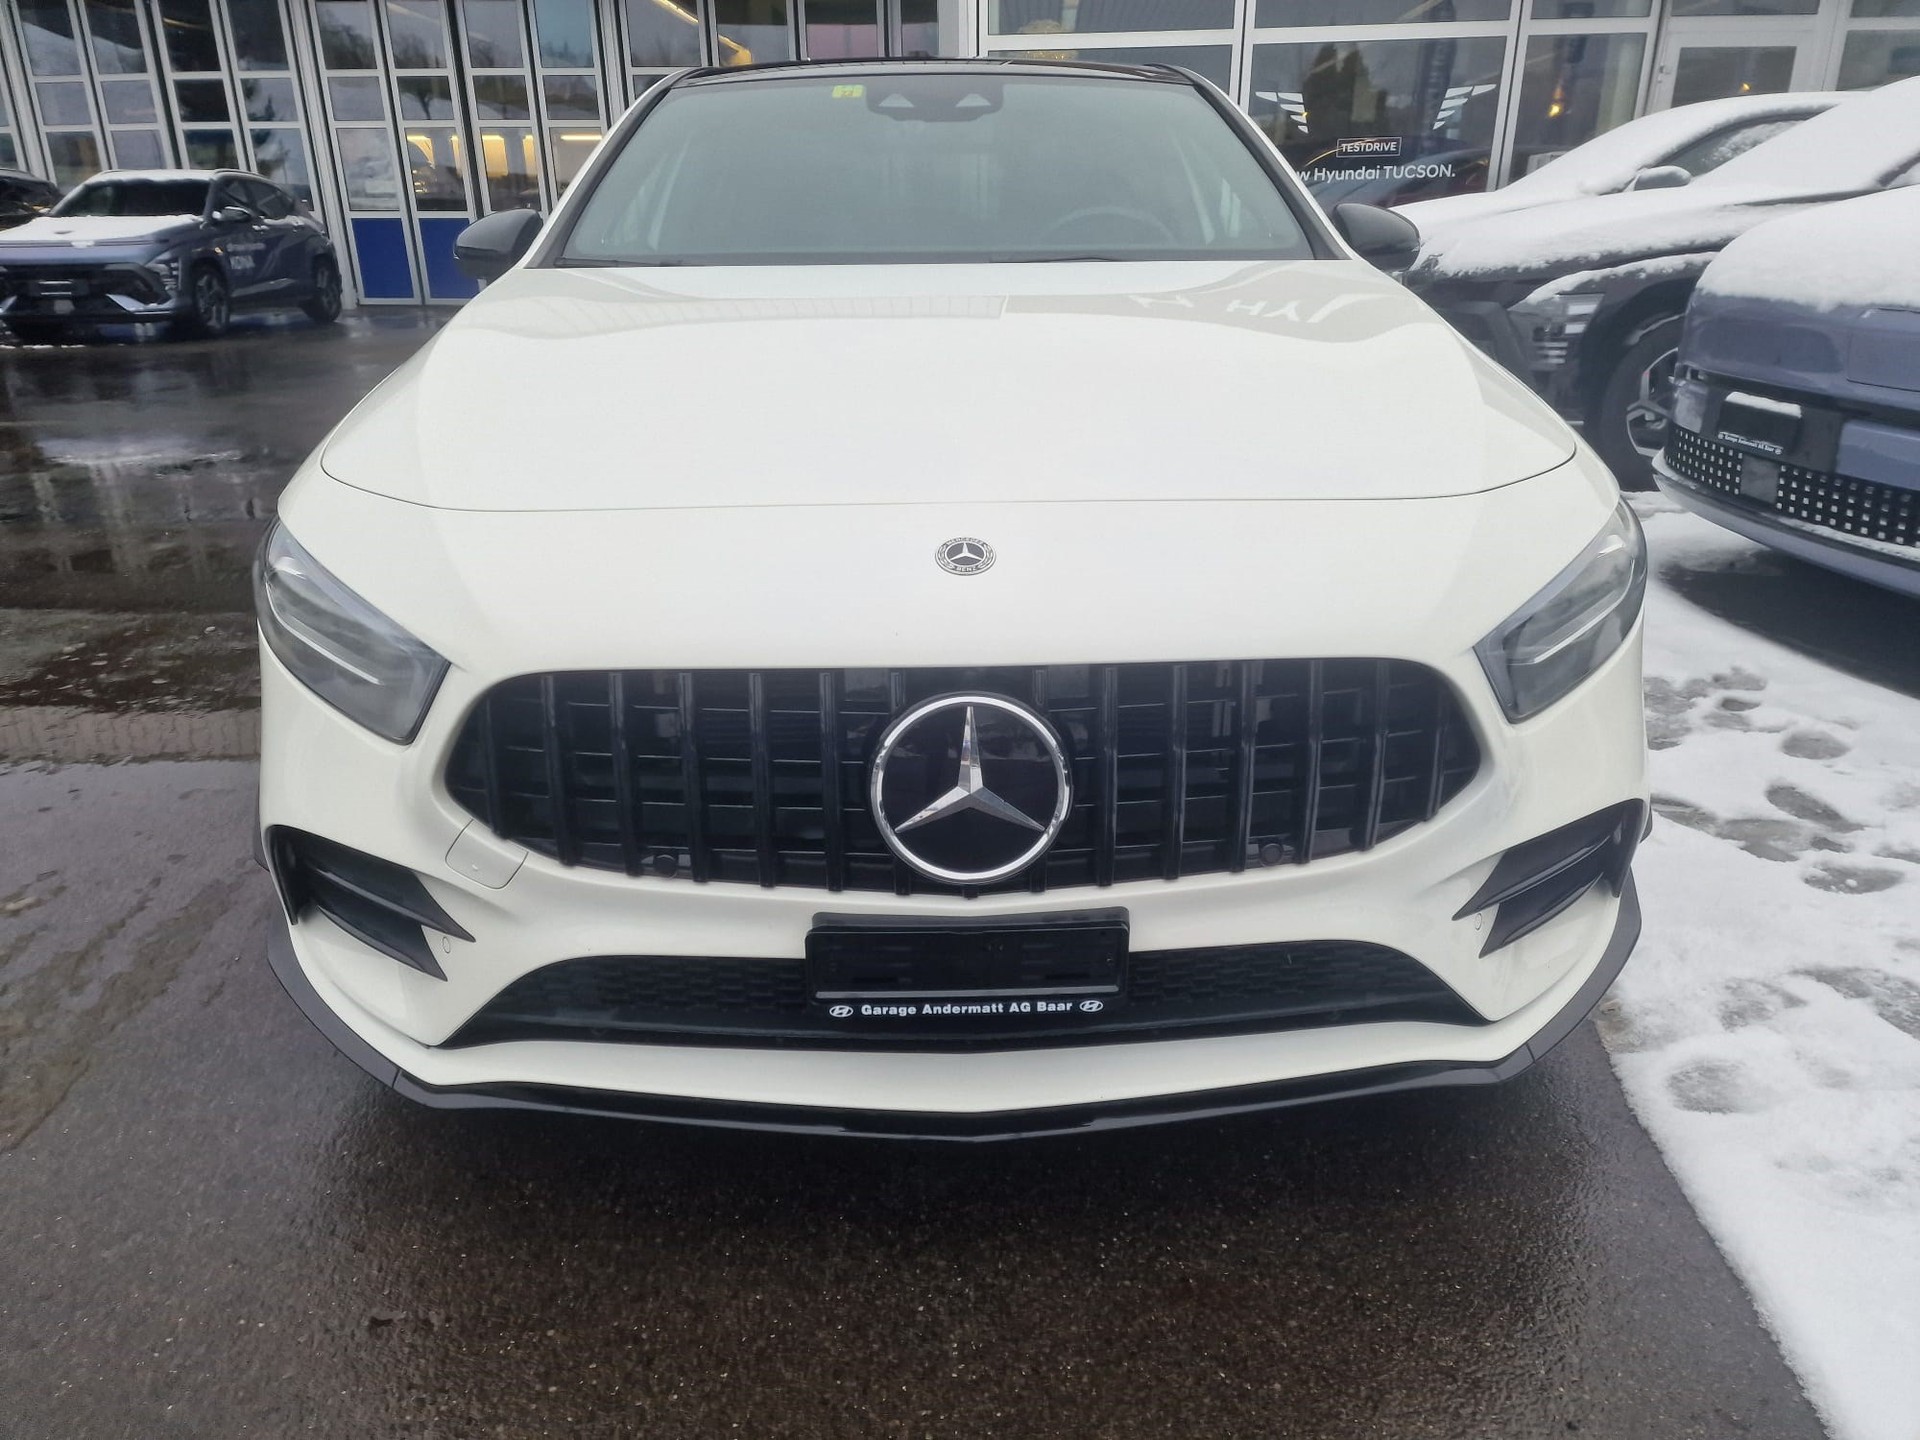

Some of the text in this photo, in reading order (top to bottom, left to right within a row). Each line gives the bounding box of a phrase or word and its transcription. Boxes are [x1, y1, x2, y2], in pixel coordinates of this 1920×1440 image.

[1341, 141, 1397, 153] TESTDRIVE
[1314, 165, 1380, 183] Hyundai
[1383, 163, 1456, 179] TUCSON.
[861, 1000, 1073, 1017] Garage Andermatt AG Baar
